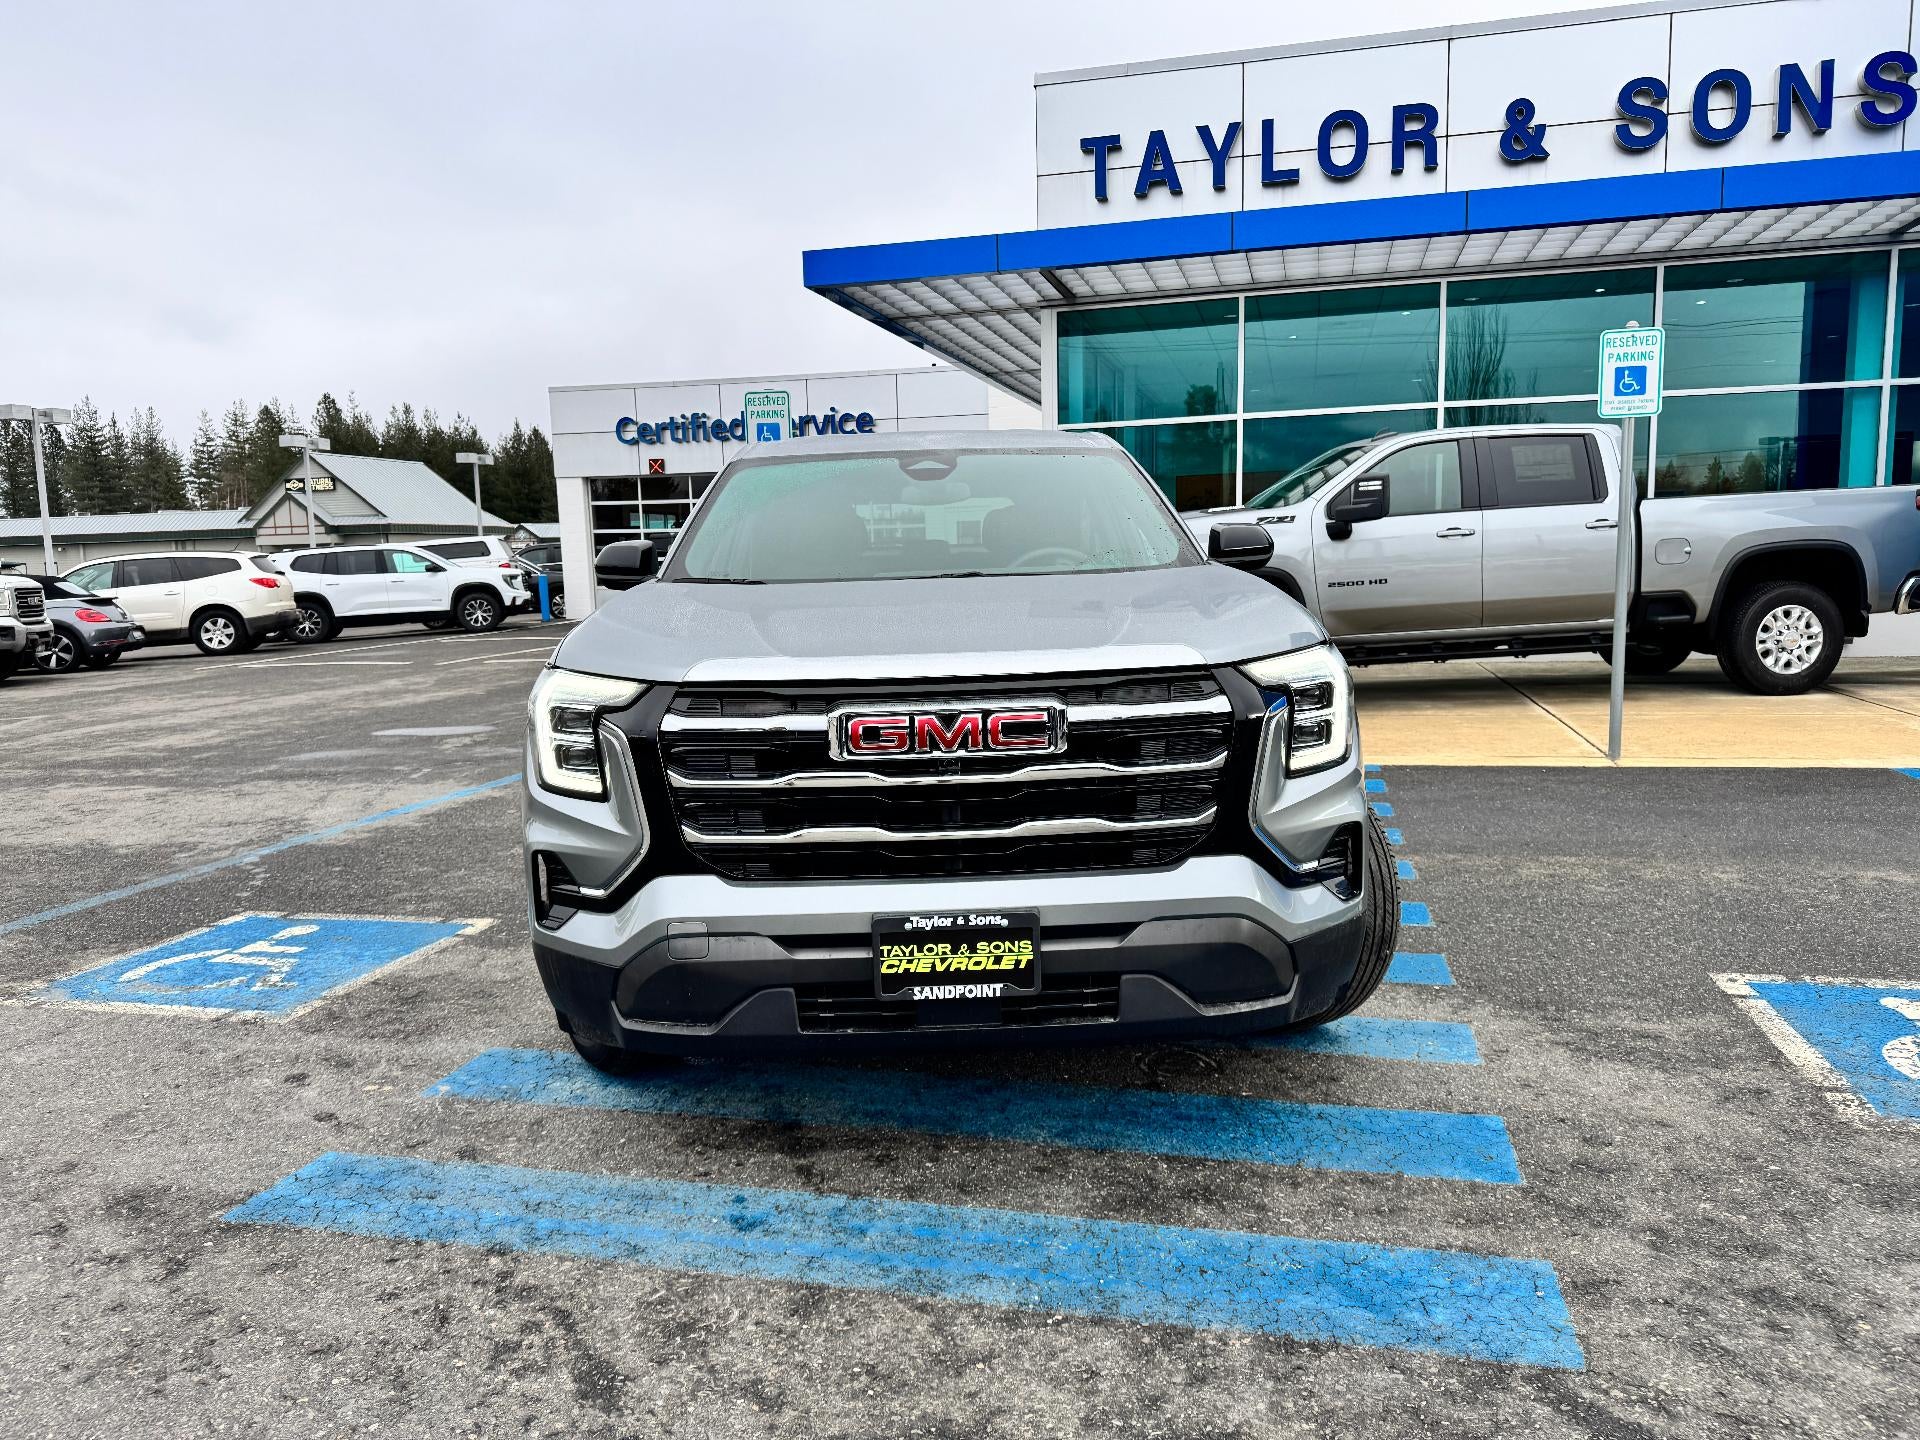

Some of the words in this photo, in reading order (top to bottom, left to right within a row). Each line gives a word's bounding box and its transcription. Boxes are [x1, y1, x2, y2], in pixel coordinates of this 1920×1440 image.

[1080, 102, 1440, 202] TAYLOR
[1499, 97, 1551, 164] &
[1612, 50, 1918, 153] SONS
[1606, 335, 1658, 348] RESERVED
[1608, 350, 1655, 363] PARKING
[747, 396, 786, 407] RESERVED
[750, 409, 785, 419] PARKING
[615, 411, 746, 445] Certified
[1328, 580, 1365, 588] 2500
[848, 711, 1050, 753] GMC
[909, 915, 954, 930] Taylor
[956, 916, 964, 925] &
[968, 914, 1001, 926] Sons
[880, 943, 951, 958] TAYLOR
[957, 944, 970, 957] &
[976, 940, 1033, 954] SONS
[880, 955, 1034, 974] CHEVROLET
[913, 984, 1004, 1000] SANDPOINT
